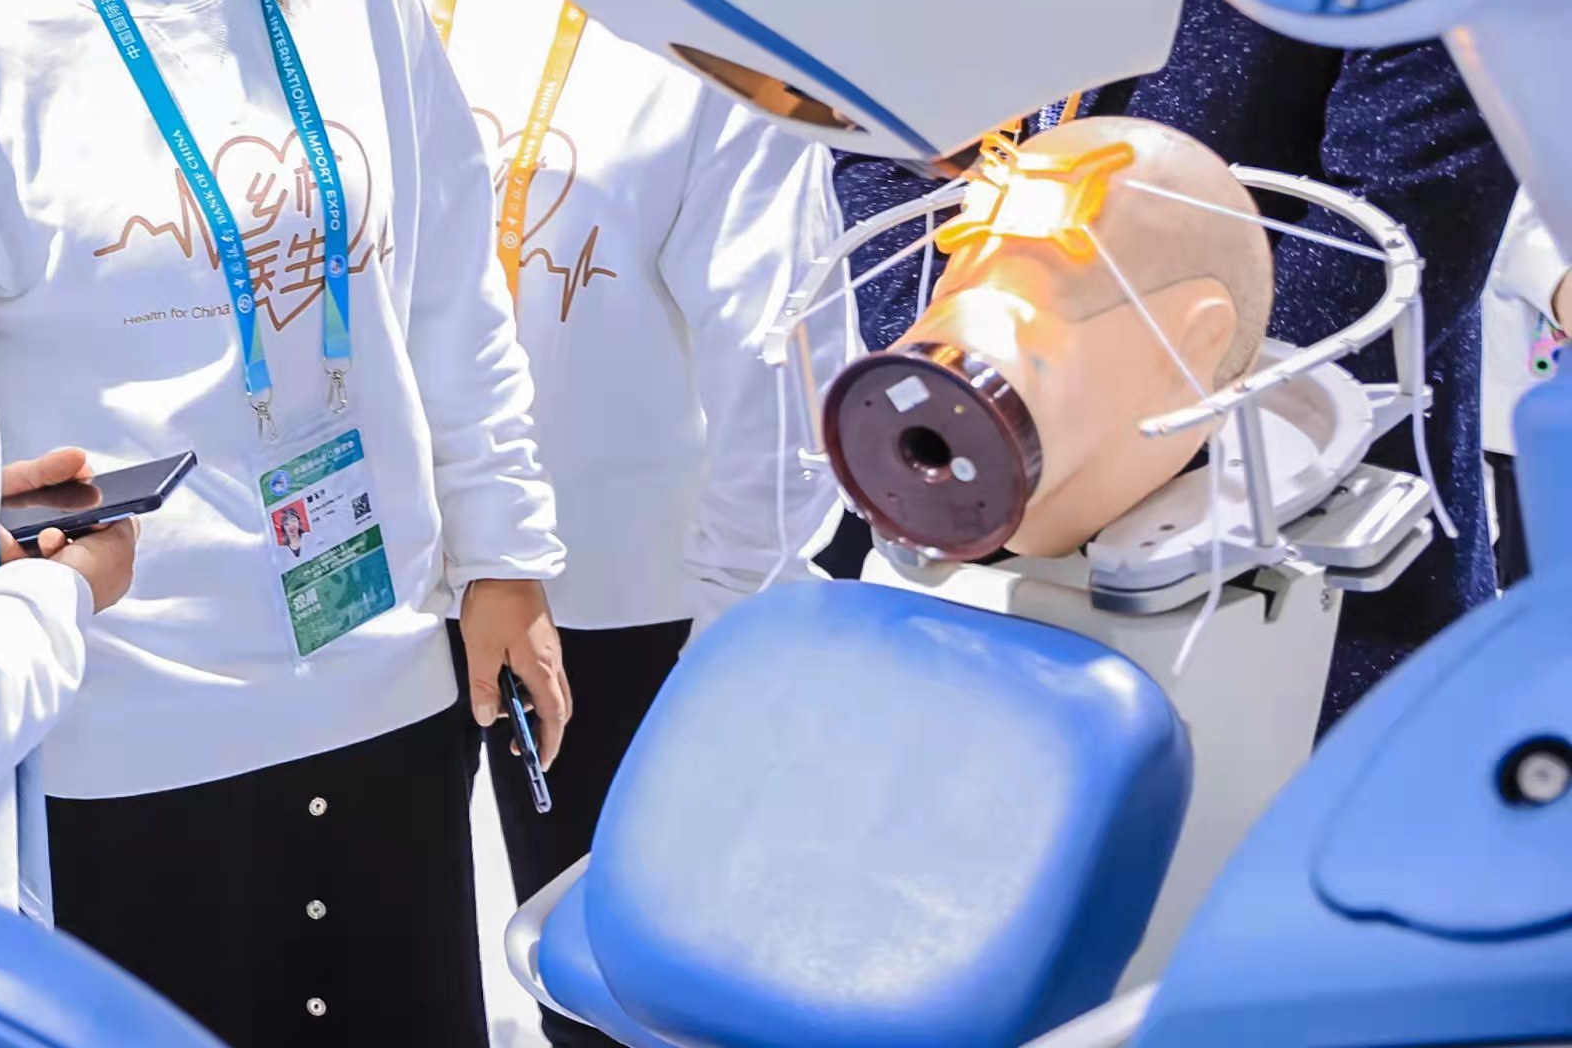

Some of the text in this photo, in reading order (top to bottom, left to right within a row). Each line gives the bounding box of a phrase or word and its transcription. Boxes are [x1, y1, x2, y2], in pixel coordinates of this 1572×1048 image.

[269, 16, 310, 130] INTERNATIONAL
[305, 130, 335, 186] IMPORT
[325, 189, 342, 232] EXPO
[171, 128, 228, 225] BANK OF CHINA
[123, 303, 230, 326] Health for China
